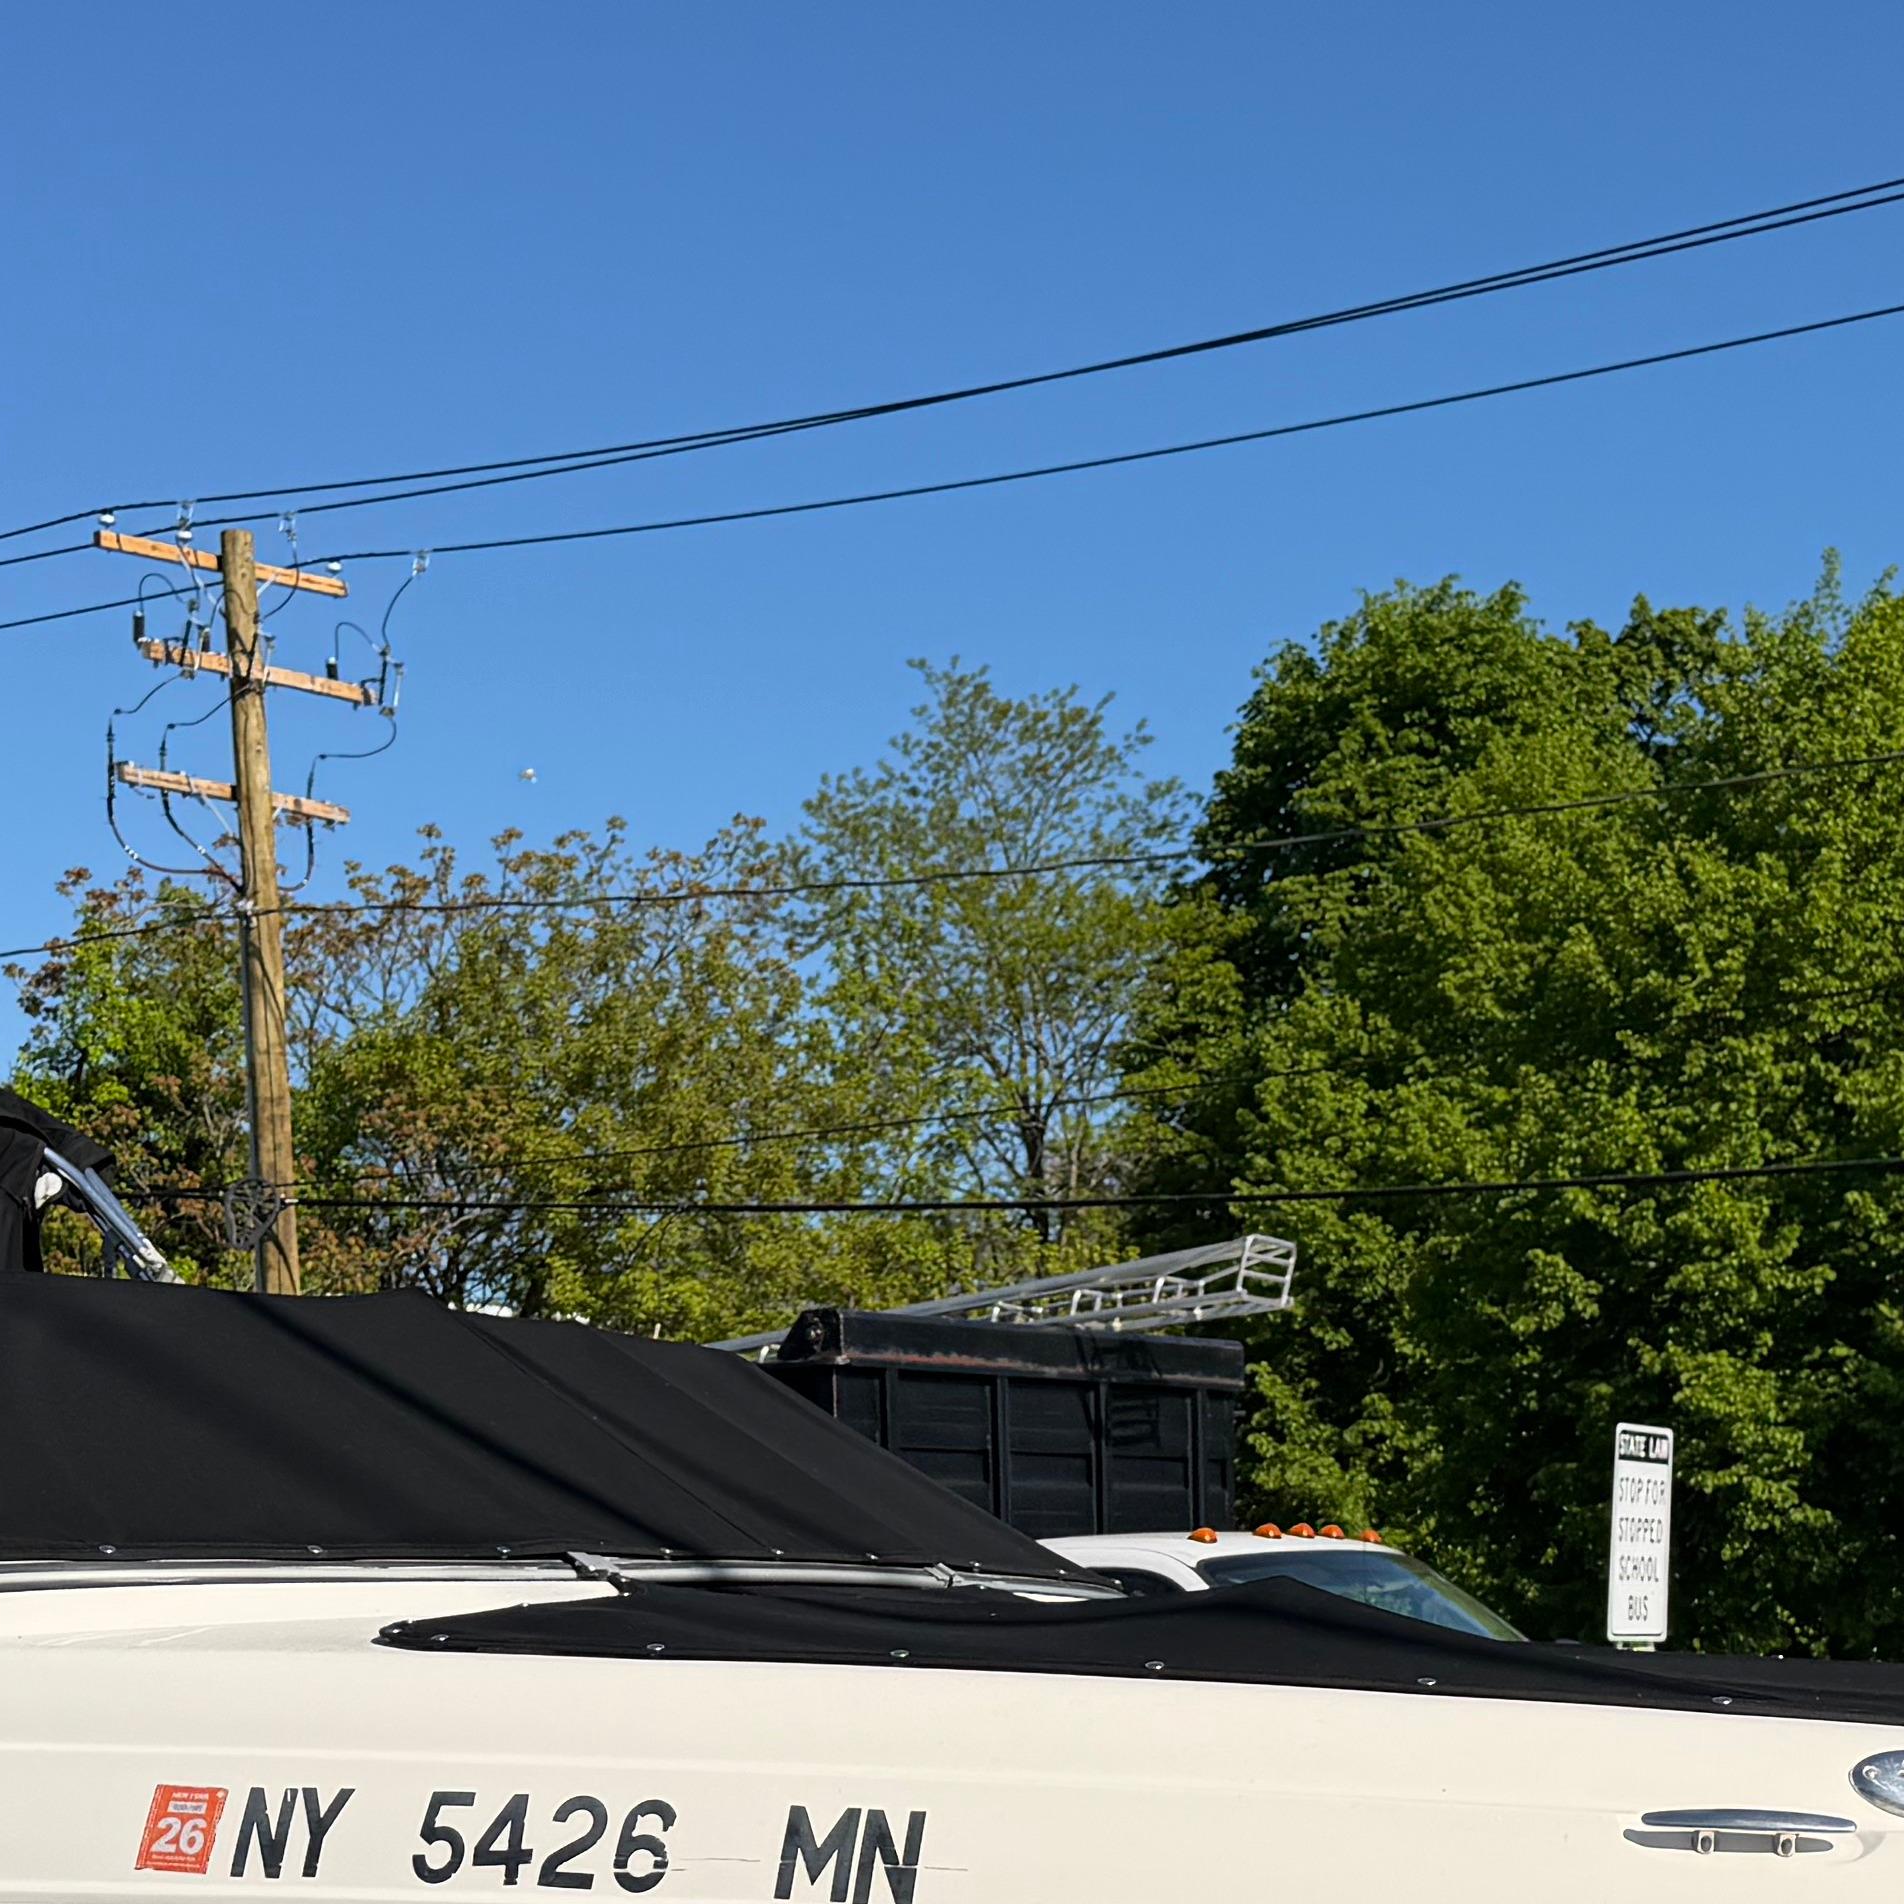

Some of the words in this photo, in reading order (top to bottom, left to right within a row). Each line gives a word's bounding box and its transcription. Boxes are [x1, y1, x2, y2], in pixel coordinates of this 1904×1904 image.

[1619, 1477, 1643, 1503] STOP
[1619, 1517, 1663, 1544] STOPPED
[1619, 1555, 1659, 1582] SCHOOL
[1628, 1595, 1648, 1621] BUS
[150, 1817, 208, 1855] 26
[231, 1787, 355, 1879] NY
[412, 1791, 677, 1893] 5426
